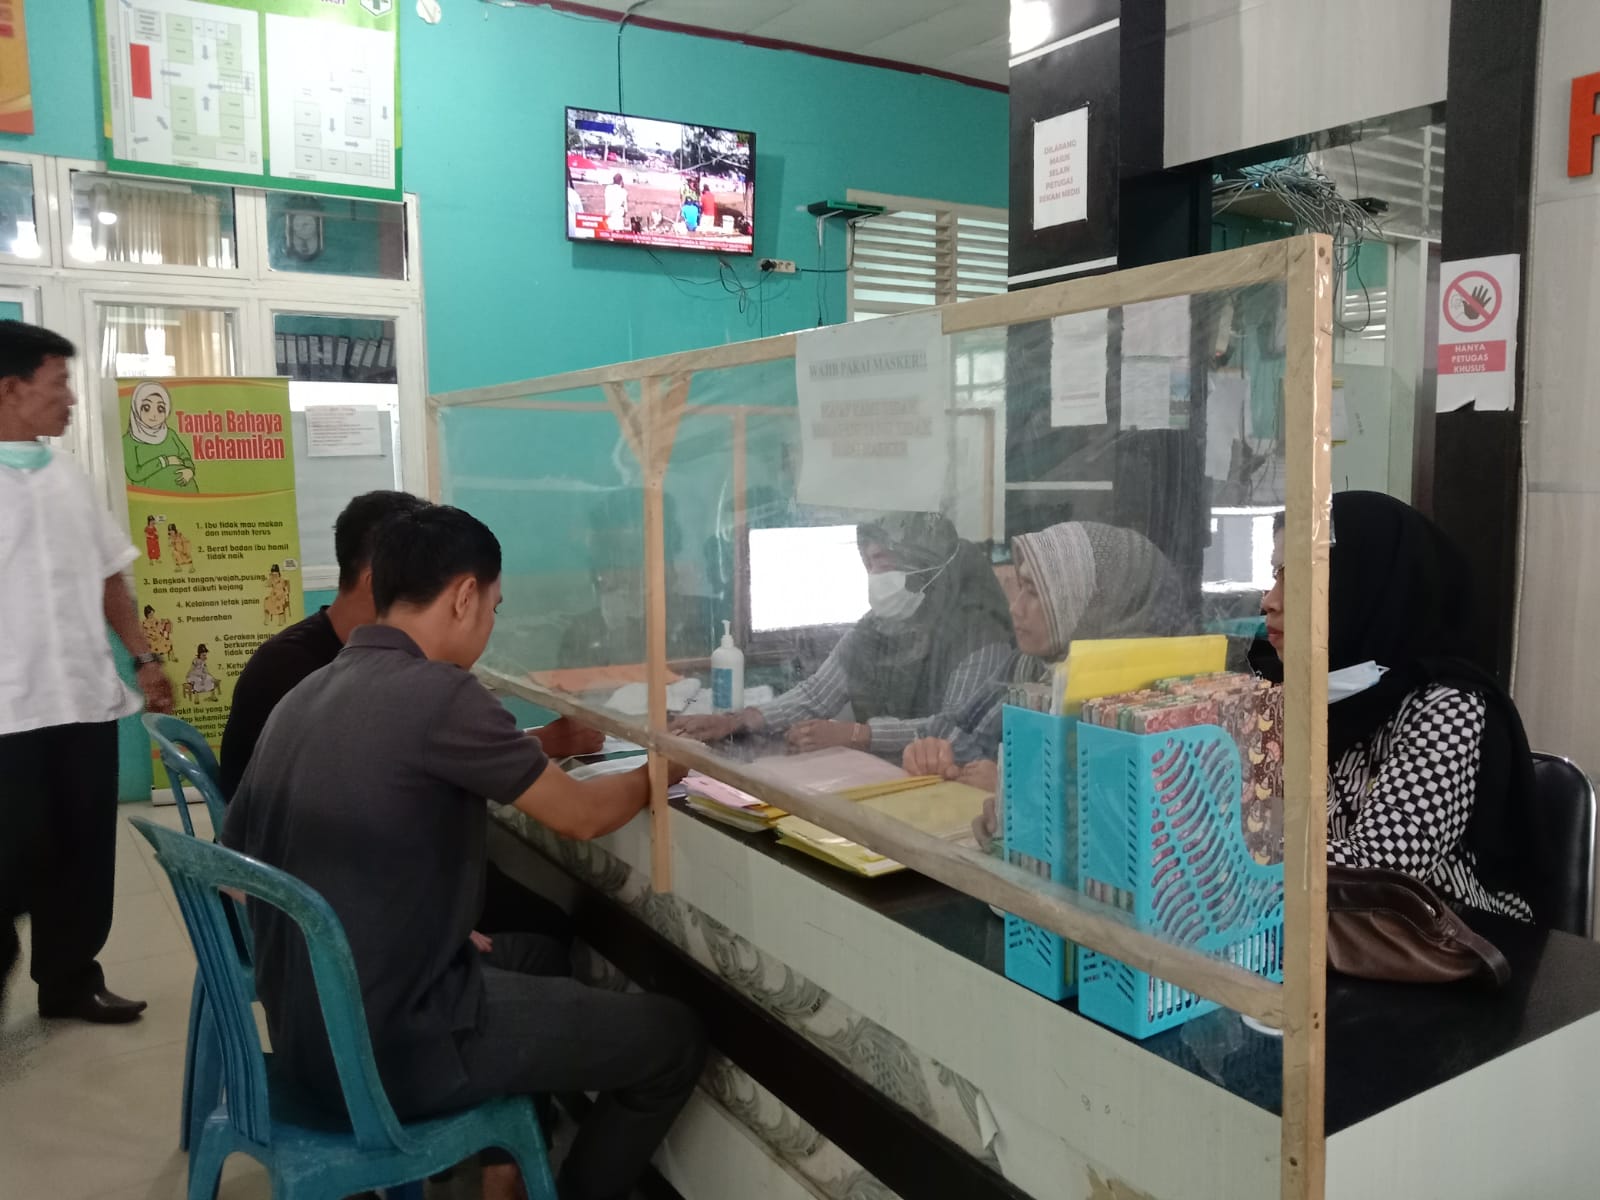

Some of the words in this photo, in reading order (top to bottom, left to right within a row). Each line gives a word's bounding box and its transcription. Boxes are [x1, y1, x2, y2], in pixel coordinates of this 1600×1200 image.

[1046, 177, 1073, 190] PETUGAS
[1455, 344, 1486, 353] HANYA
[1452, 354, 1489, 363] PETUGAS
[840, 359, 870, 376] PAKAI
[1454, 364, 1486, 373] KHUSUS
[176, 410, 223, 434] Tanda
[226, 411, 283, 435] Bahaya
[192, 435, 286, 460] Kehamilan
[196, 522, 203, 530] 1.
[220, 521, 239, 529] tidak
[258, 520, 284, 528] makan
[222, 529, 250, 537] muntah
[207, 545, 228, 553] Berat
[230, 544, 253, 552] badan
[228, 552, 244, 560] naik
[153, 577, 186, 586] Bengkak
[170, 586, 191, 595] dapat
[193, 585, 217, 593] diikuti
[219, 584, 244, 592] kejang
[185, 600, 220, 608] Kelainan
[177, 616, 185, 624] 5.
[187, 614, 233, 623] Pendarahan
[224, 633, 255, 641] Gerakan
[206, 706, 224, 714] yang
